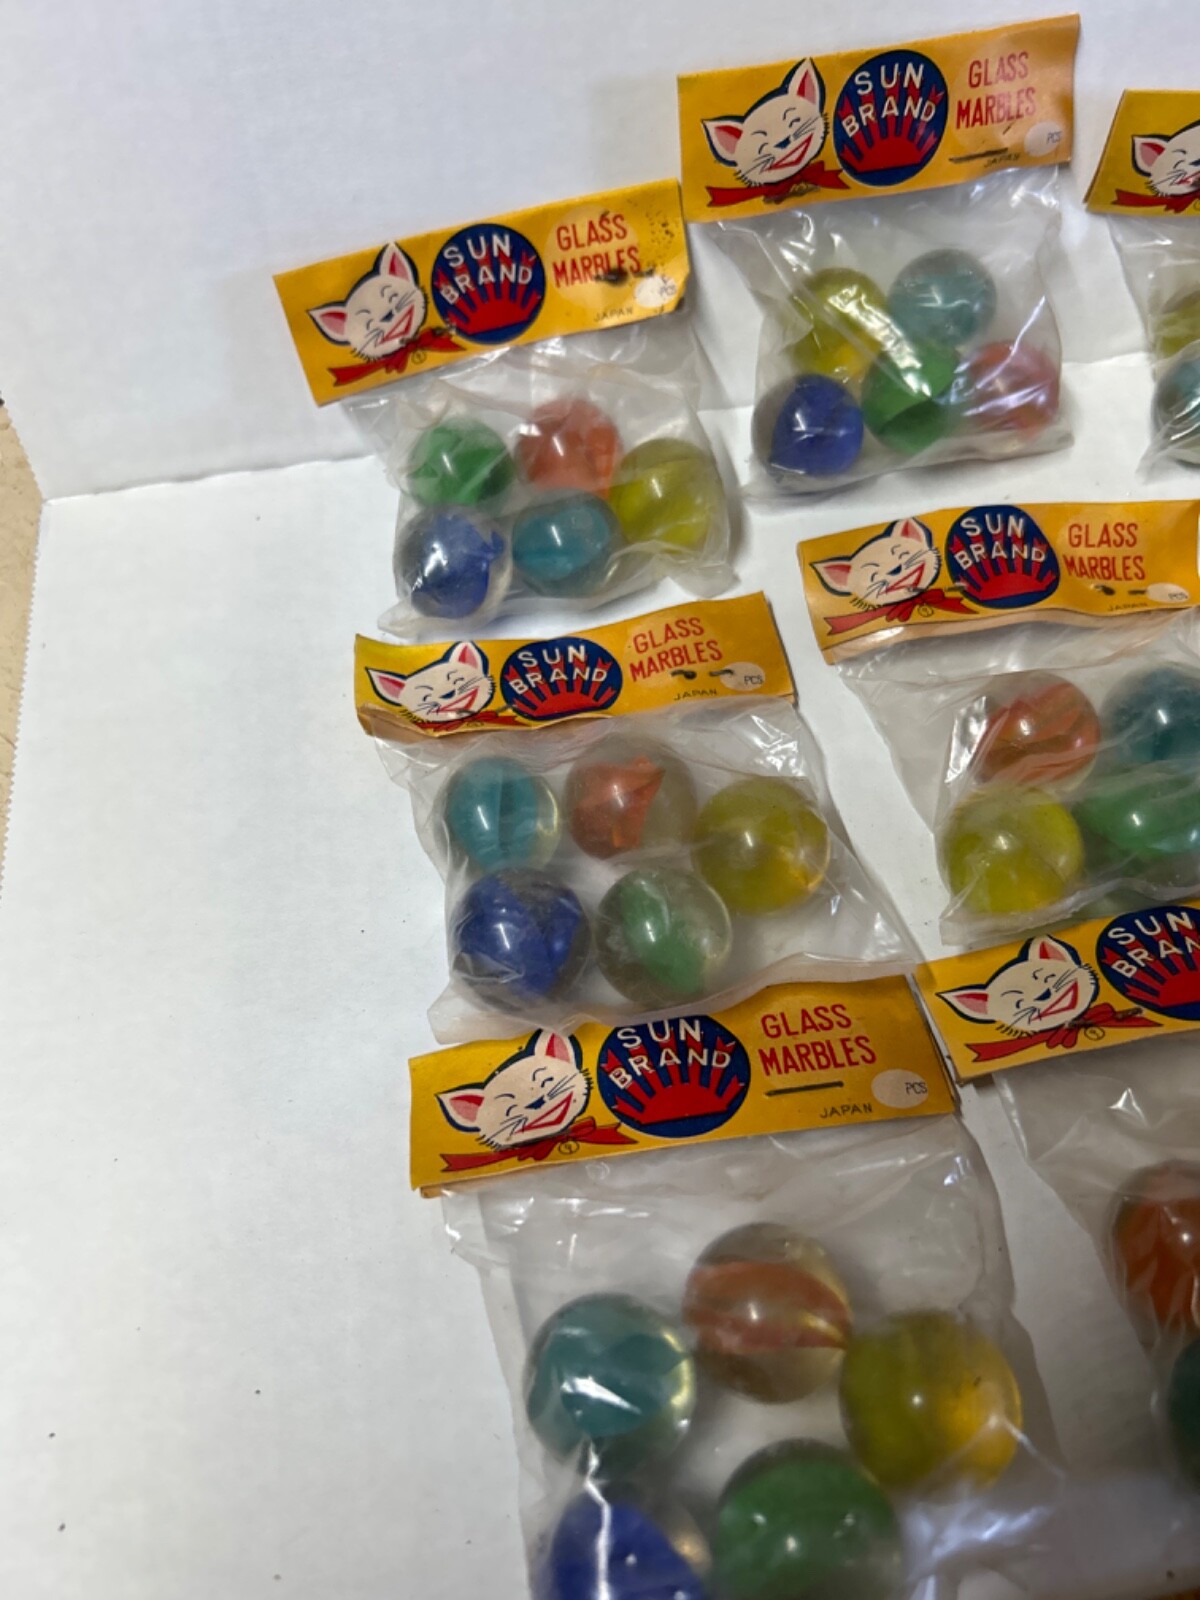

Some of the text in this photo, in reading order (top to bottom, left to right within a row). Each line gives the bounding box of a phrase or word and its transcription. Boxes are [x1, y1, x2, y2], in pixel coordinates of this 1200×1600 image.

[854, 62, 924, 95] SUN
[968, 51, 1029, 89] GLASS
[841, 95, 936, 138] BRAND
[956, 86, 1036, 130] MARBLES
[556, 214, 627, 251] GLASS
[443, 234, 511, 268] SUN
[440, 263, 533, 305] BRAND
[960, 513, 1024, 538] SUN
[1068, 522, 1138, 548] GLASS
[953, 541, 1046, 570] BRAND
[1062, 554, 1146, 581] MARBLES
[633, 617, 704, 654] GLASS
[517, 644, 586, 668] SUN
[629, 640, 723, 682] MARBLES
[508, 667, 608, 695] BRAND
[744, 675, 763, 685] PCS
[1107, 911, 1193, 945] SUN
[616, 1018, 702, 1049] SUN
[760, 1003, 852, 1039] GLASS
[608, 1047, 732, 1090] BRAND
[757, 1035, 877, 1077] MARBLES
[905, 1081, 928, 1095] PCS
[819, 1103, 873, 1119] JAPAN
